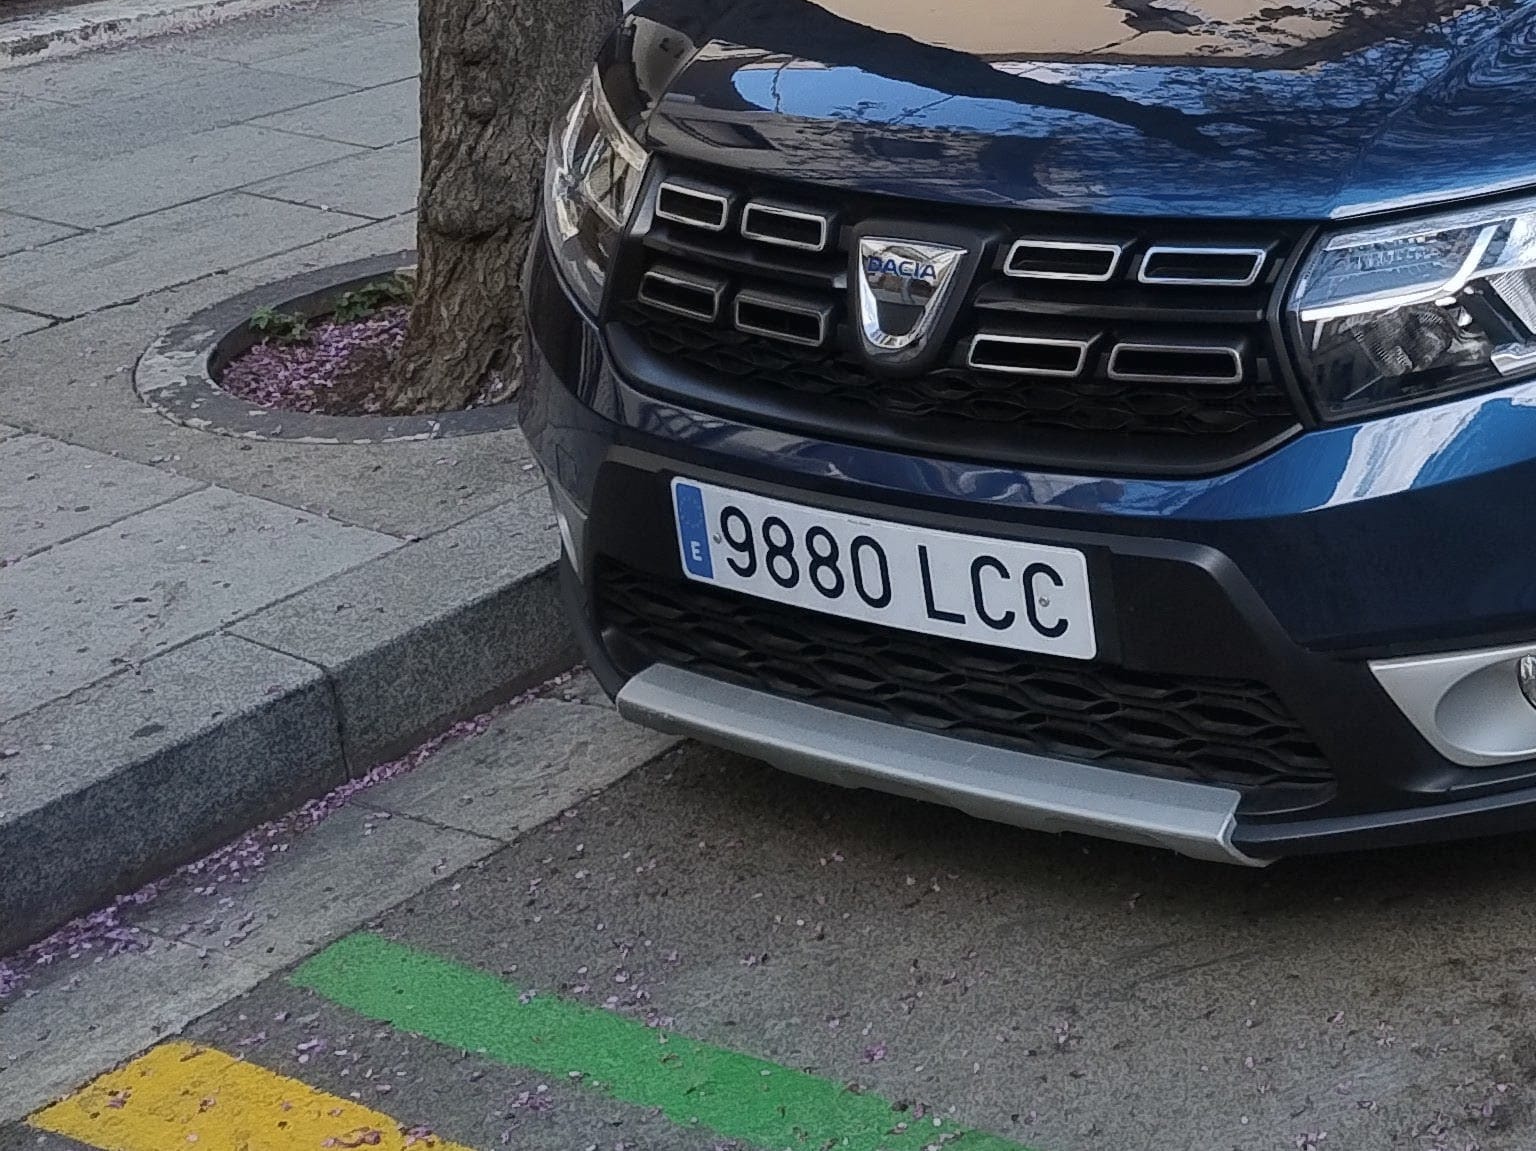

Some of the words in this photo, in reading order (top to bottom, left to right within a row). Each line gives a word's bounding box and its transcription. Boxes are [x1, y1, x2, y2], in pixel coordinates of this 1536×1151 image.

[867, 256, 937, 280] DACIA
[690, 540, 703, 562] E
[720, 505, 892, 609] 9880
[917, 544, 1069, 638] LCC
